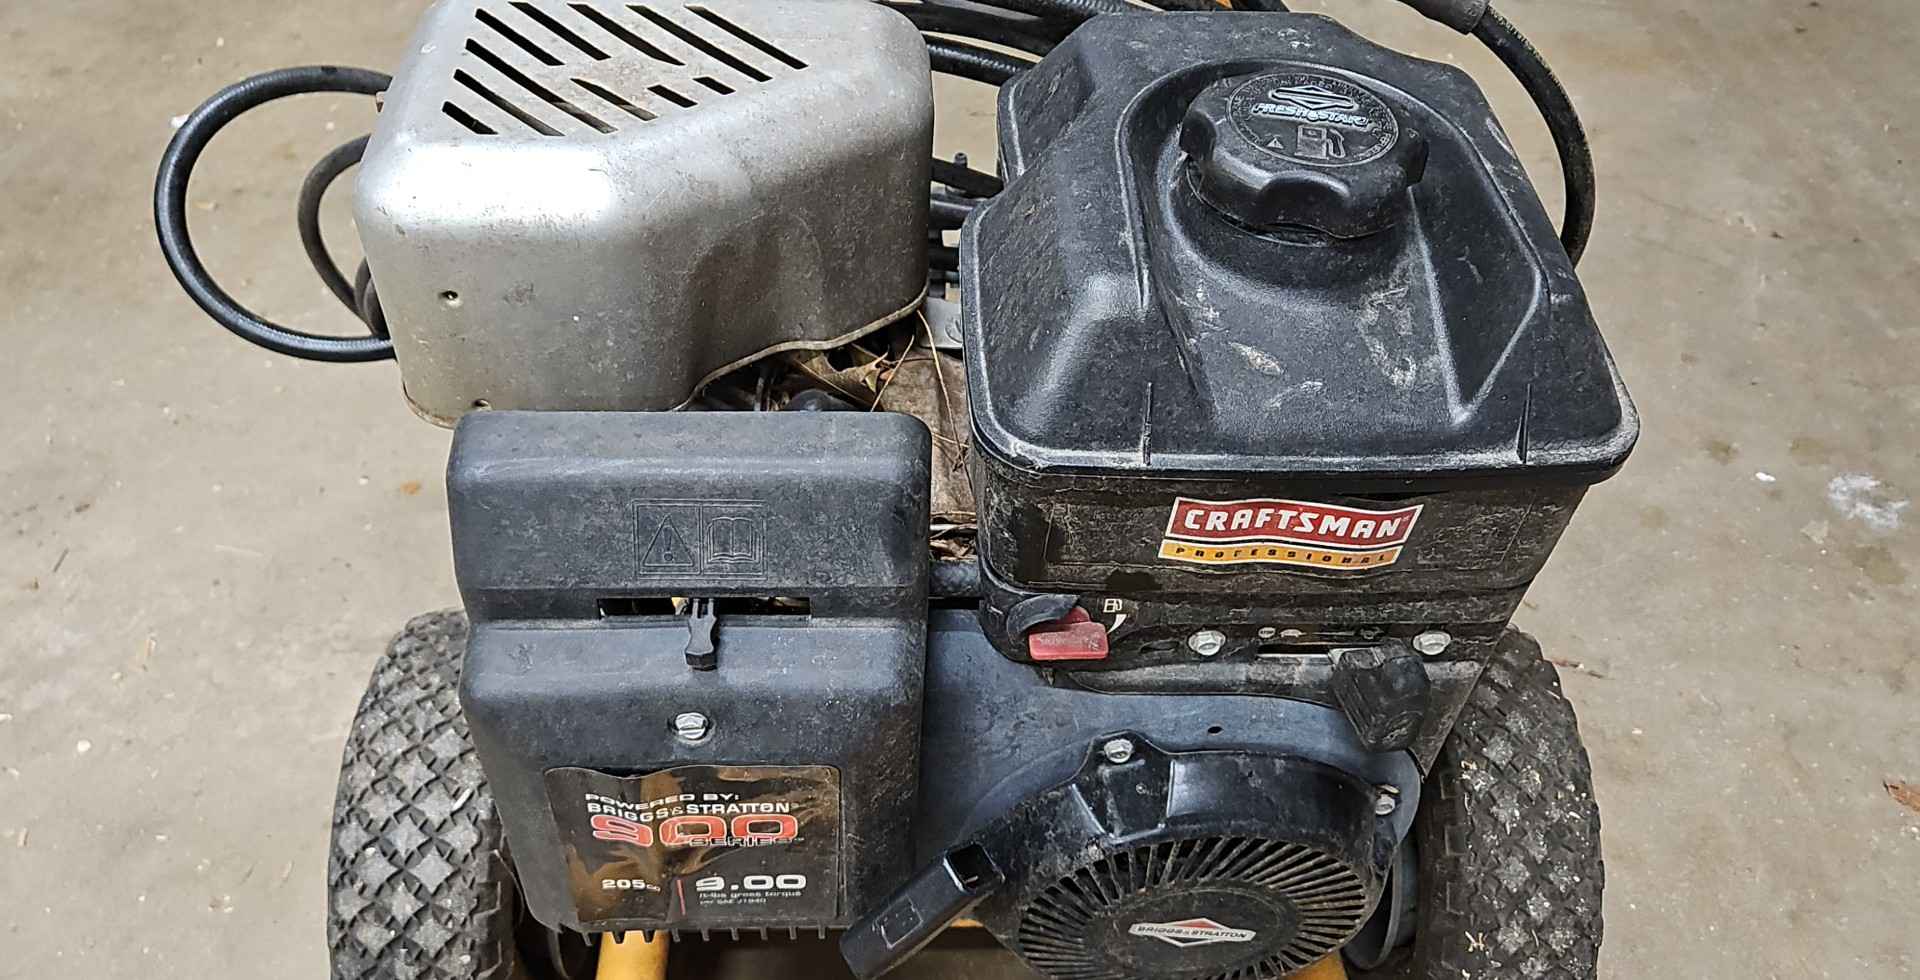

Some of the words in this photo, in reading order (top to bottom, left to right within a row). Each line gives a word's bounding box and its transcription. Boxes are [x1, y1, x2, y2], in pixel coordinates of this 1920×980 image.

[1184, 508, 1401, 538] CRAFTSMAN
[1176, 547, 1386, 564] PROFESSIONAL
[585, 793, 695, 810] POWERED
[703, 793, 739, 801] BY:
[591, 814, 799, 848] 900
[696, 874, 807, 892] 9.00
